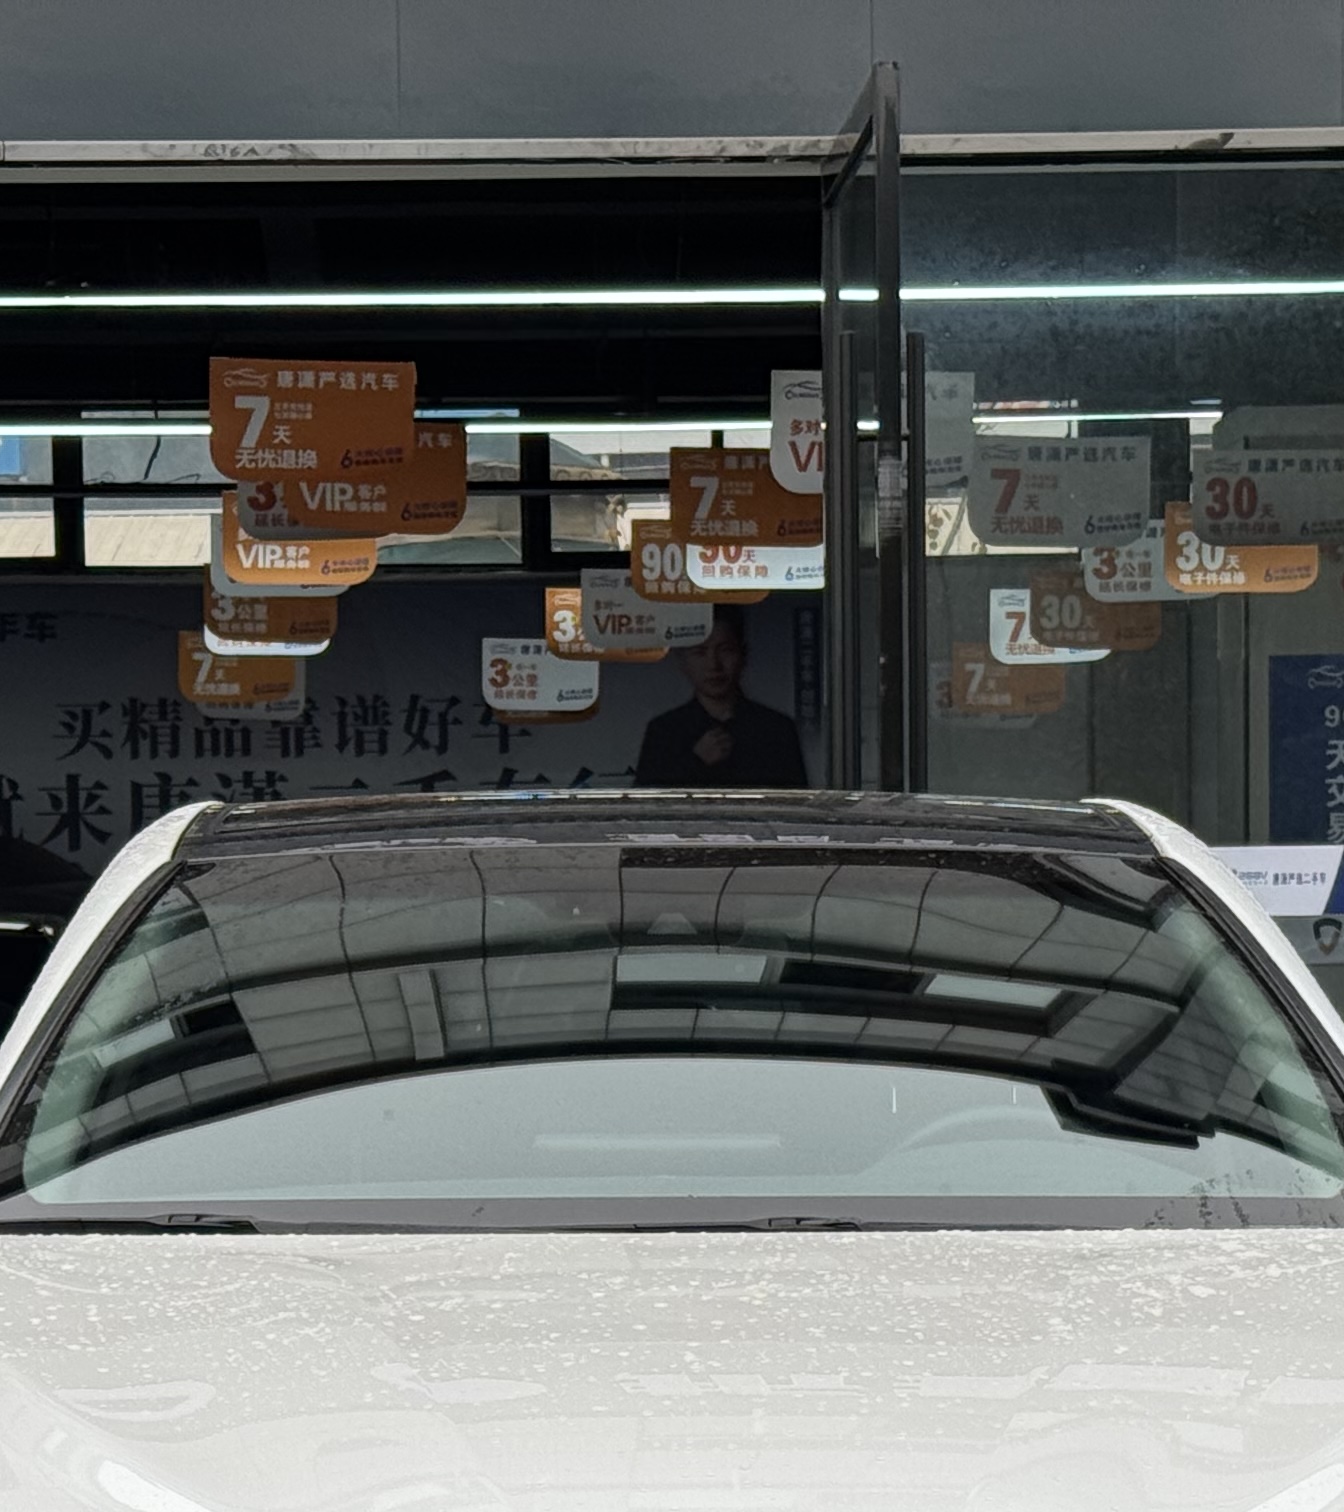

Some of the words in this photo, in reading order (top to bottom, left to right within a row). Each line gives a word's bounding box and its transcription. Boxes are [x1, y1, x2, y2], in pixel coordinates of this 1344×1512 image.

[234, 448, 317, 470] 无忧退换
[237, 544, 283, 568] VIP
